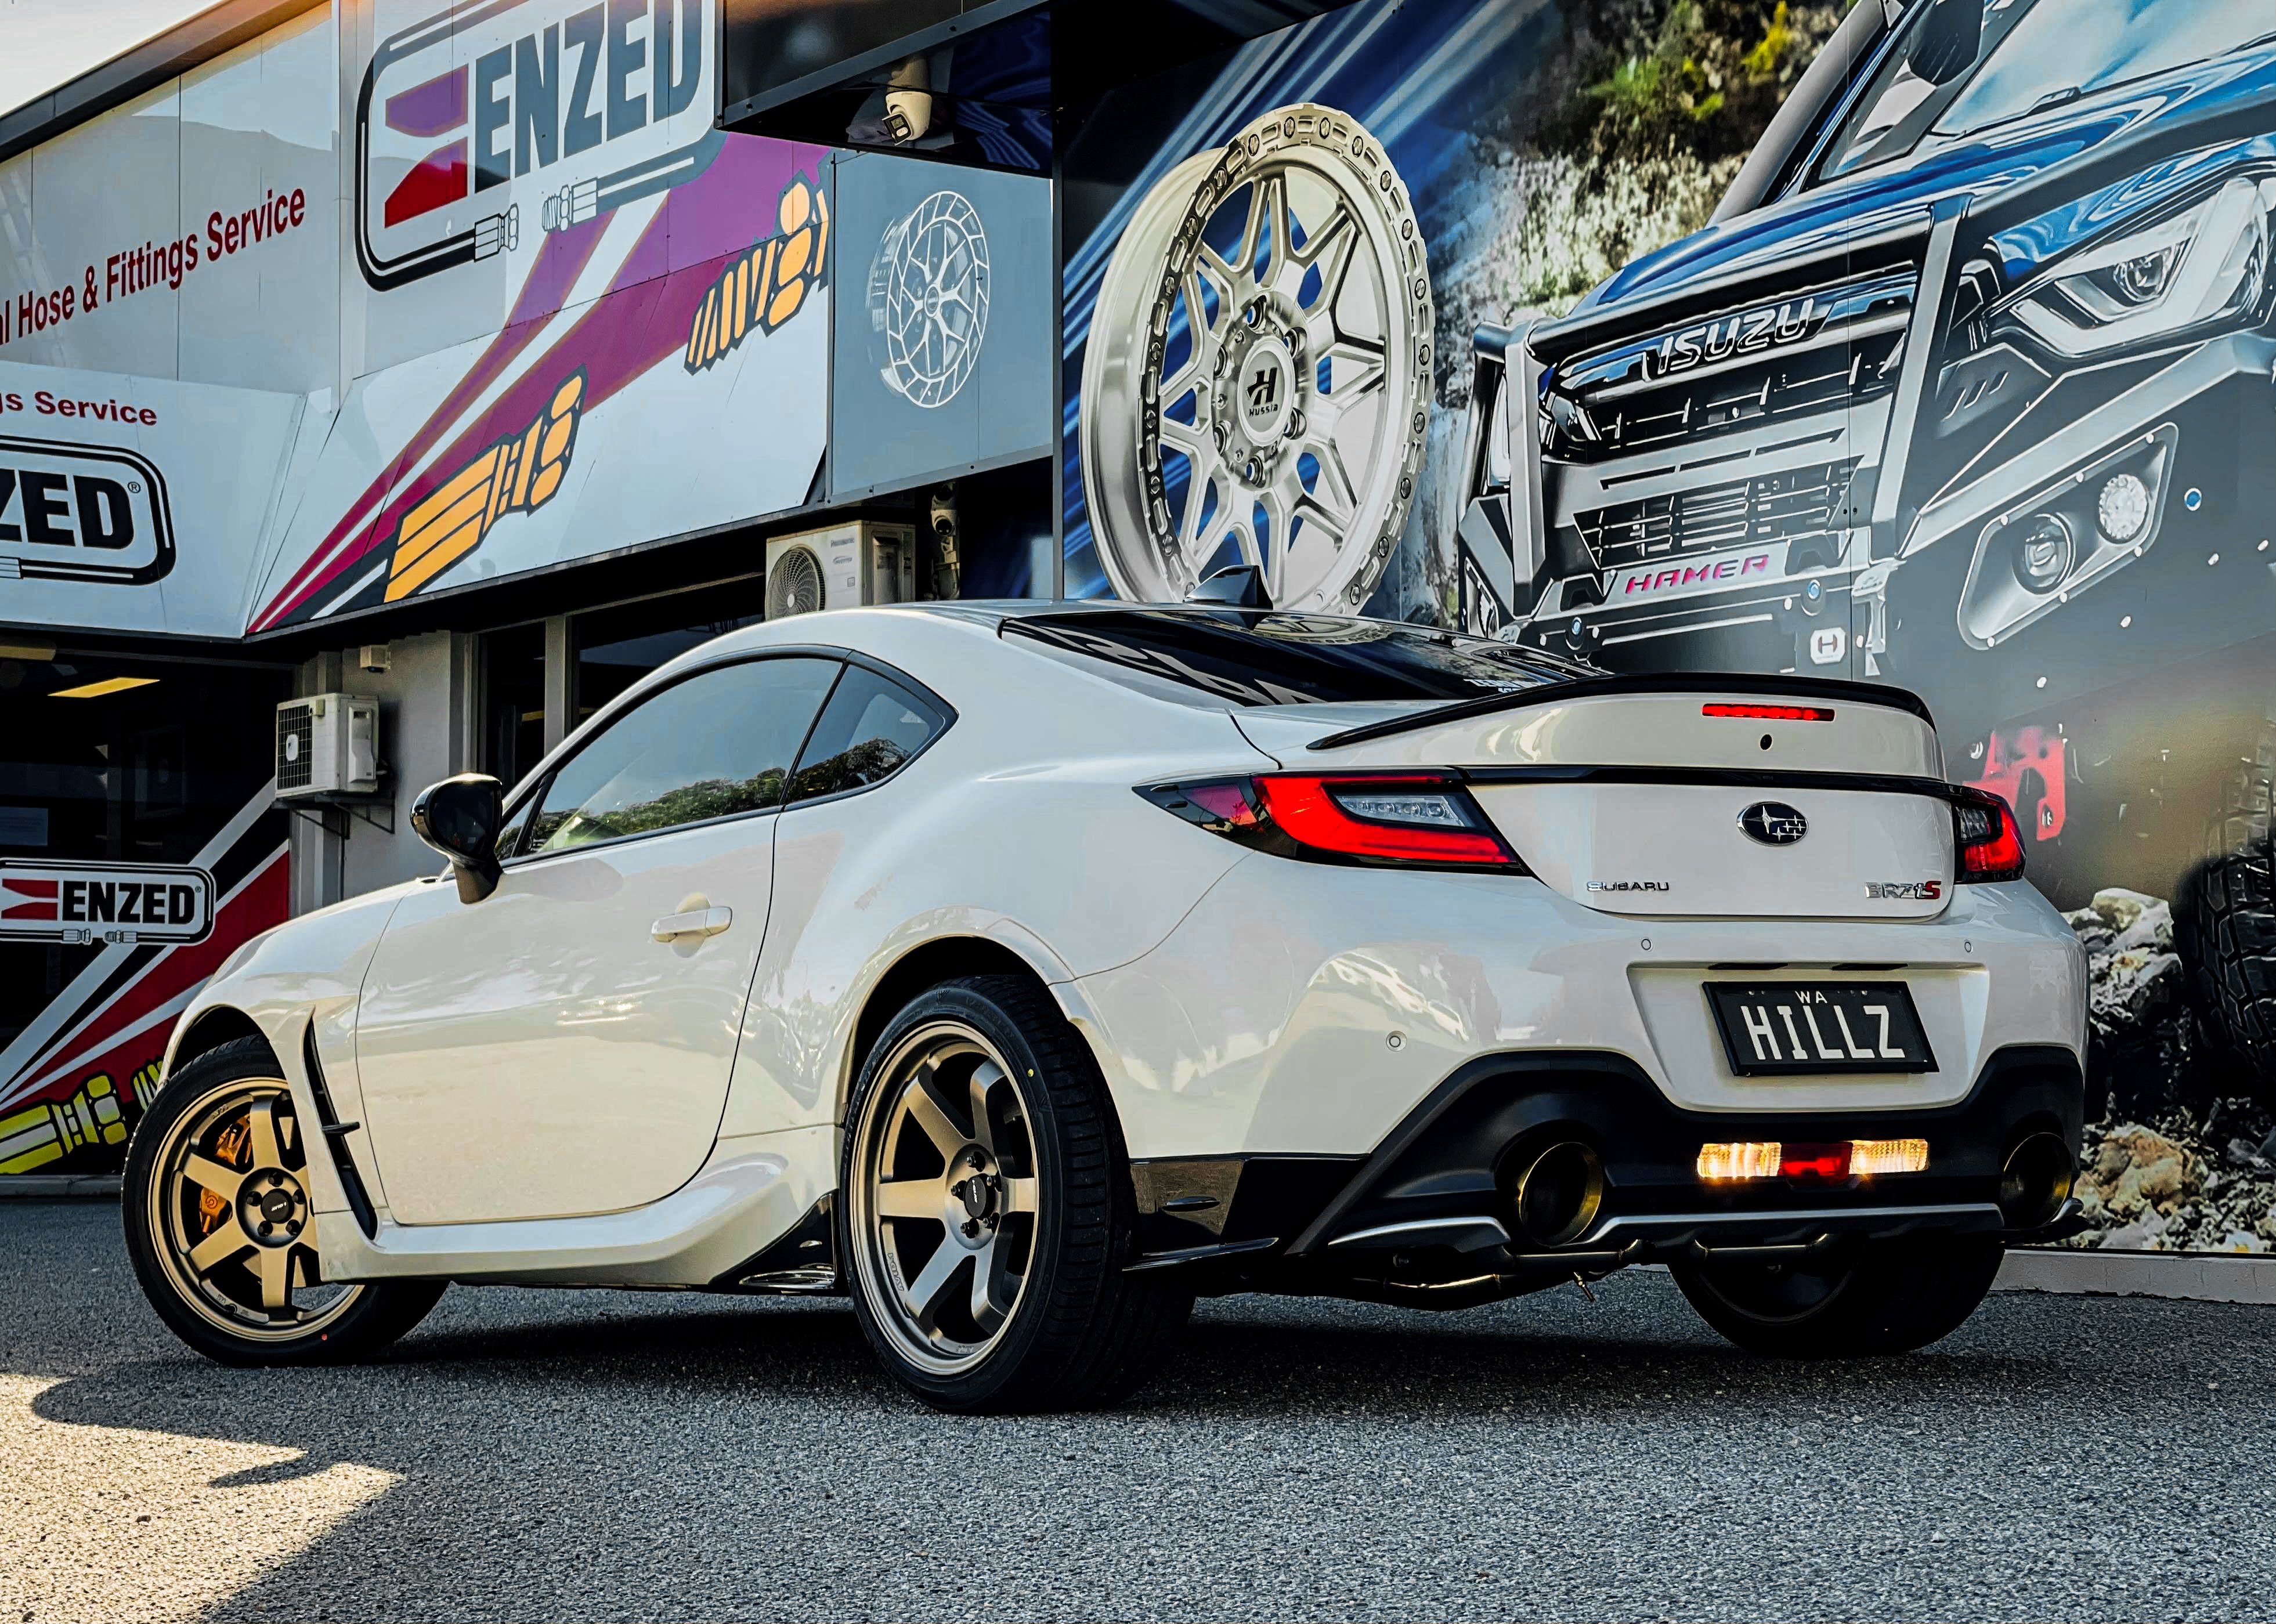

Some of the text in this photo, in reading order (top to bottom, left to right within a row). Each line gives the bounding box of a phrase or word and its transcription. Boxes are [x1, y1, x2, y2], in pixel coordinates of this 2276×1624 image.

[474, 0, 701, 193] ENZED
[19, 285, 74, 338] Hose
[82, 265, 98, 313] &
[106, 233, 198, 302] Fittings
[207, 188, 305, 261] Service
[1657, 297, 1814, 375] ISUZU
[0, 391, 158, 426] s Service
[1625, 554, 1769, 595] HAMER
[62, 880, 195, 924] ENZED
[1587, 881, 1670, 892] SUBARU
[1794, 990, 1828, 1004] WA
[1740, 1004, 1906, 1061] HILLZ
